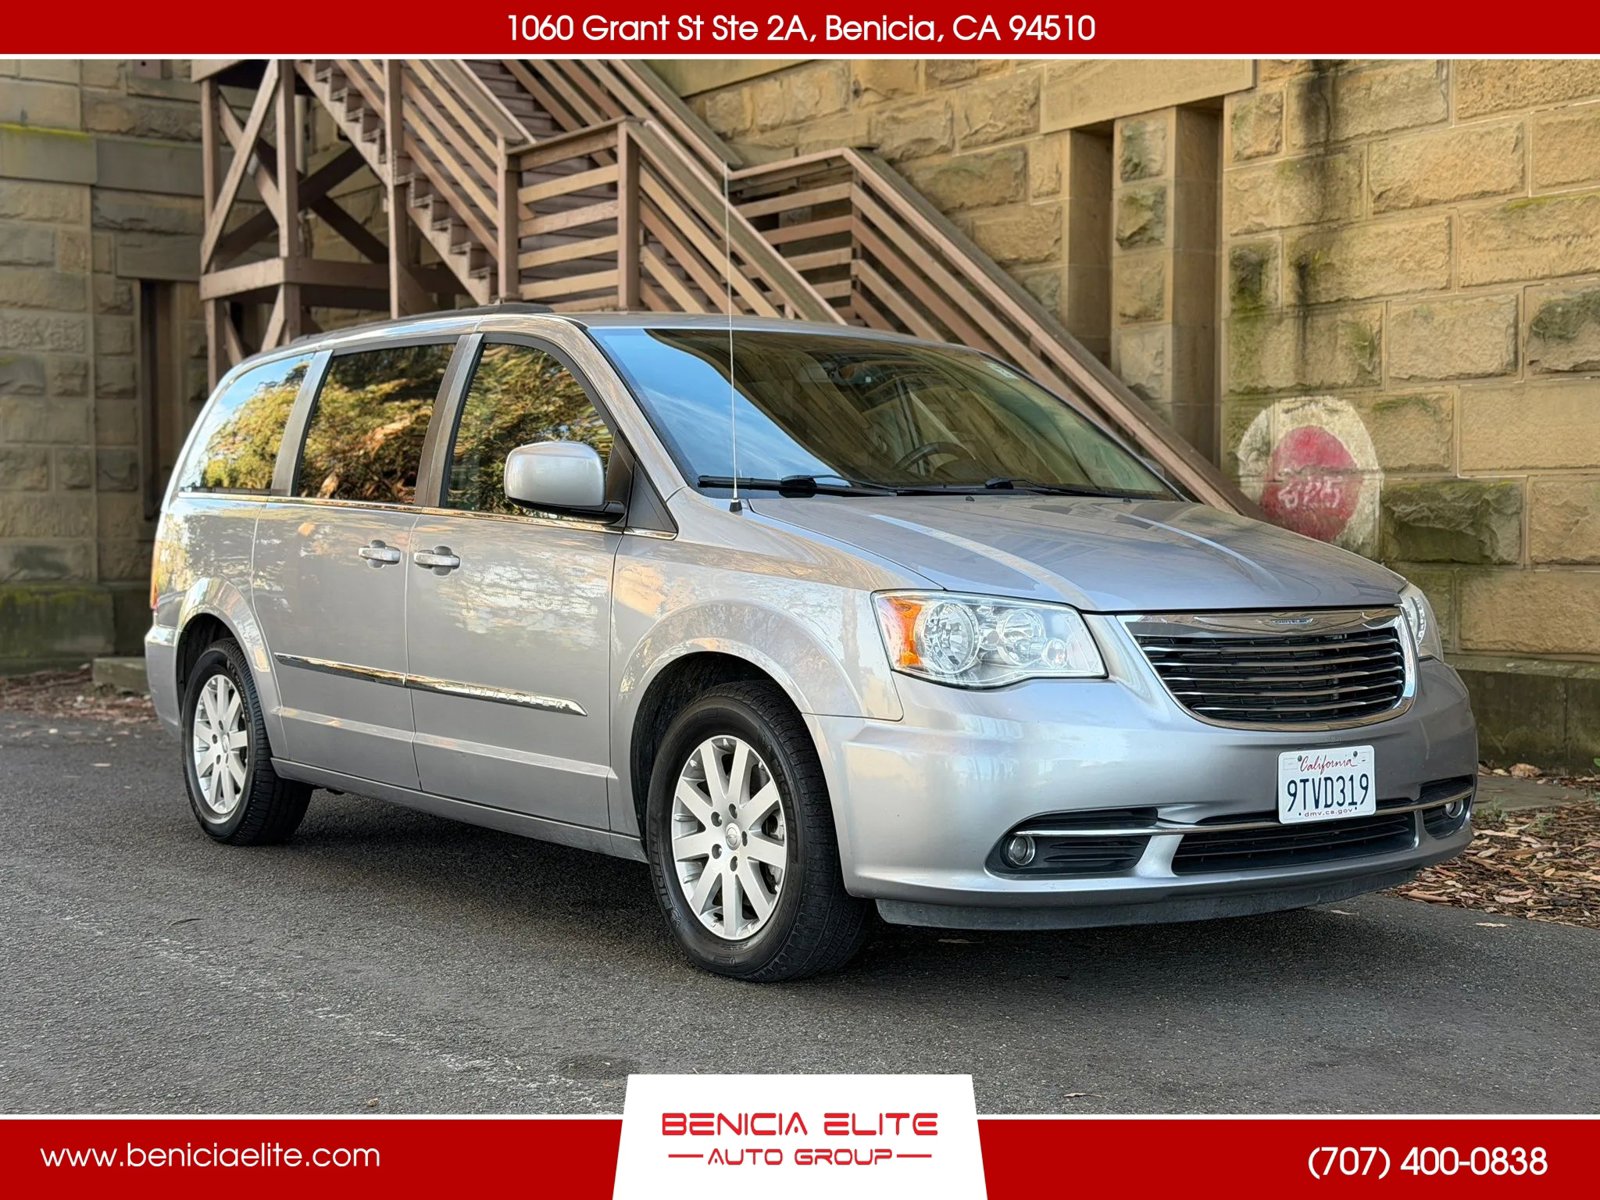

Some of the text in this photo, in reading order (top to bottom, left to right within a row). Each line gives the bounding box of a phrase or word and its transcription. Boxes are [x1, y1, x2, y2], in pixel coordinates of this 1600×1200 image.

[1300, 754, 1358, 775] California
[1286, 773, 1370, 813] 9TVD319
[1304, 808, 1354, 818] dmv.ca.gov
